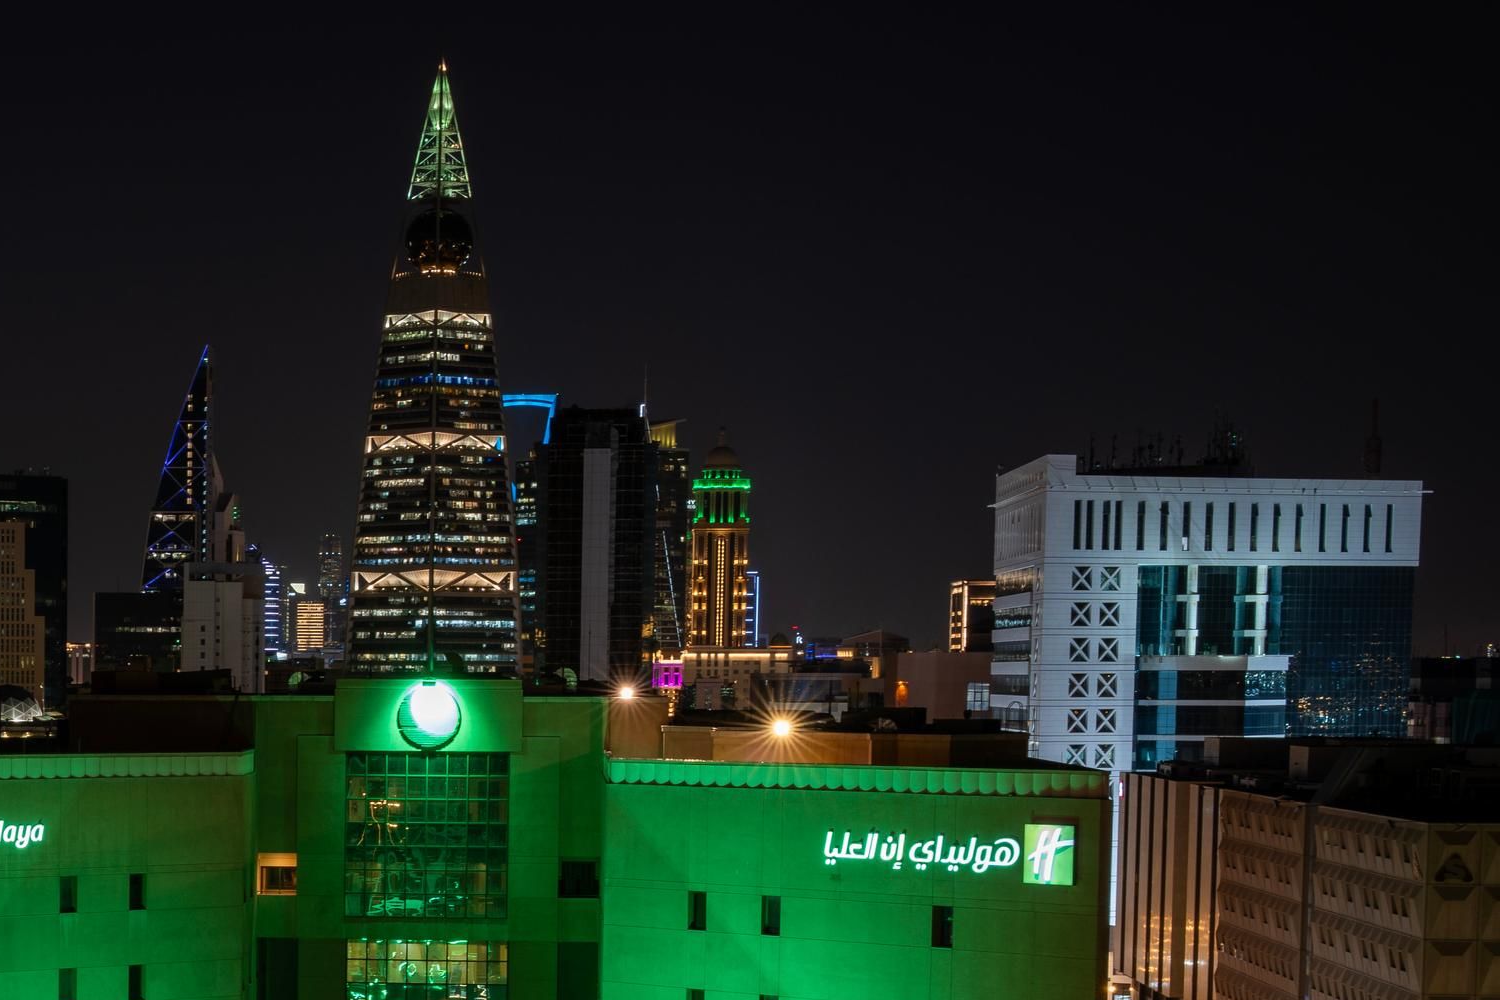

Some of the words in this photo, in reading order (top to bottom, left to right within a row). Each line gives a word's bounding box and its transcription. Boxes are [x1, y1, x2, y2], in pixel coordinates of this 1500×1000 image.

[824, 831, 879, 865] العليا
[880, 833, 905, 869] إن
[909, 834, 1021, 873] هوليداي
